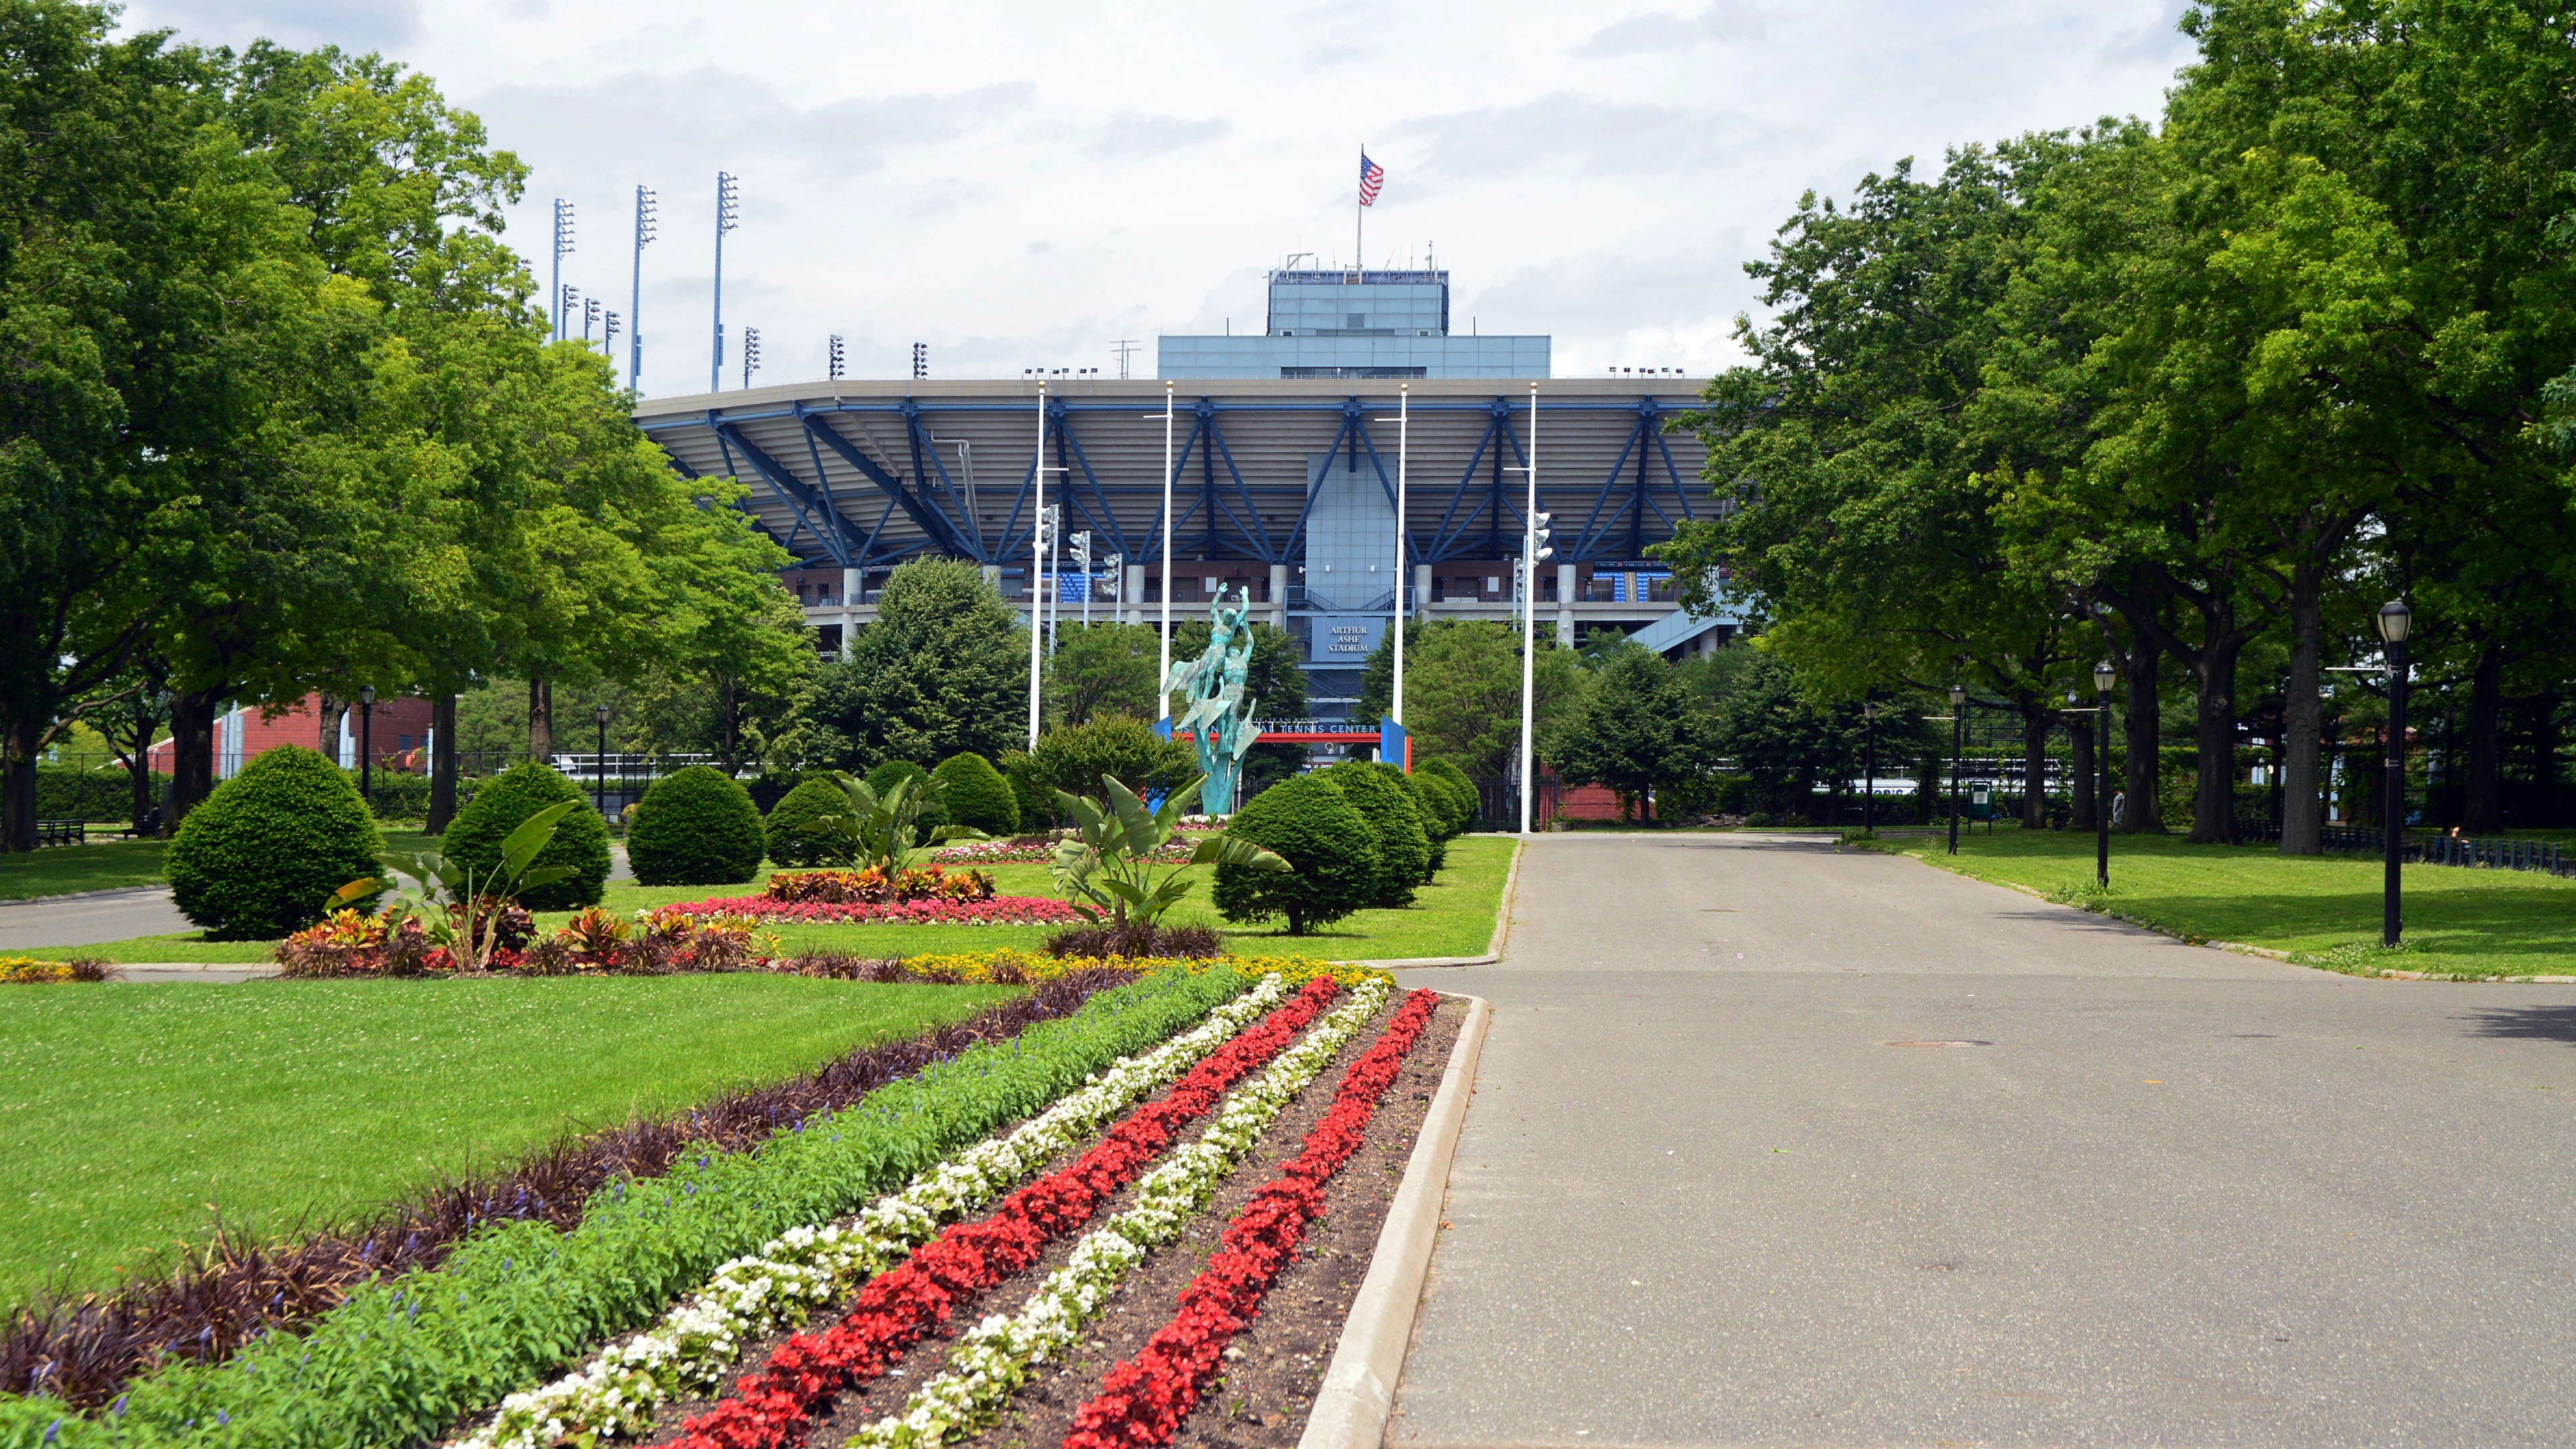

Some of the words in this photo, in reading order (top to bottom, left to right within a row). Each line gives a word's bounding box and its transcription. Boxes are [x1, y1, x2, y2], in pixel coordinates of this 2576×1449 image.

[1330, 627, 1367, 635] ARTHUR
[1280, 725, 1324, 733] TENNIS
[1330, 725, 1377, 733] CENTER
